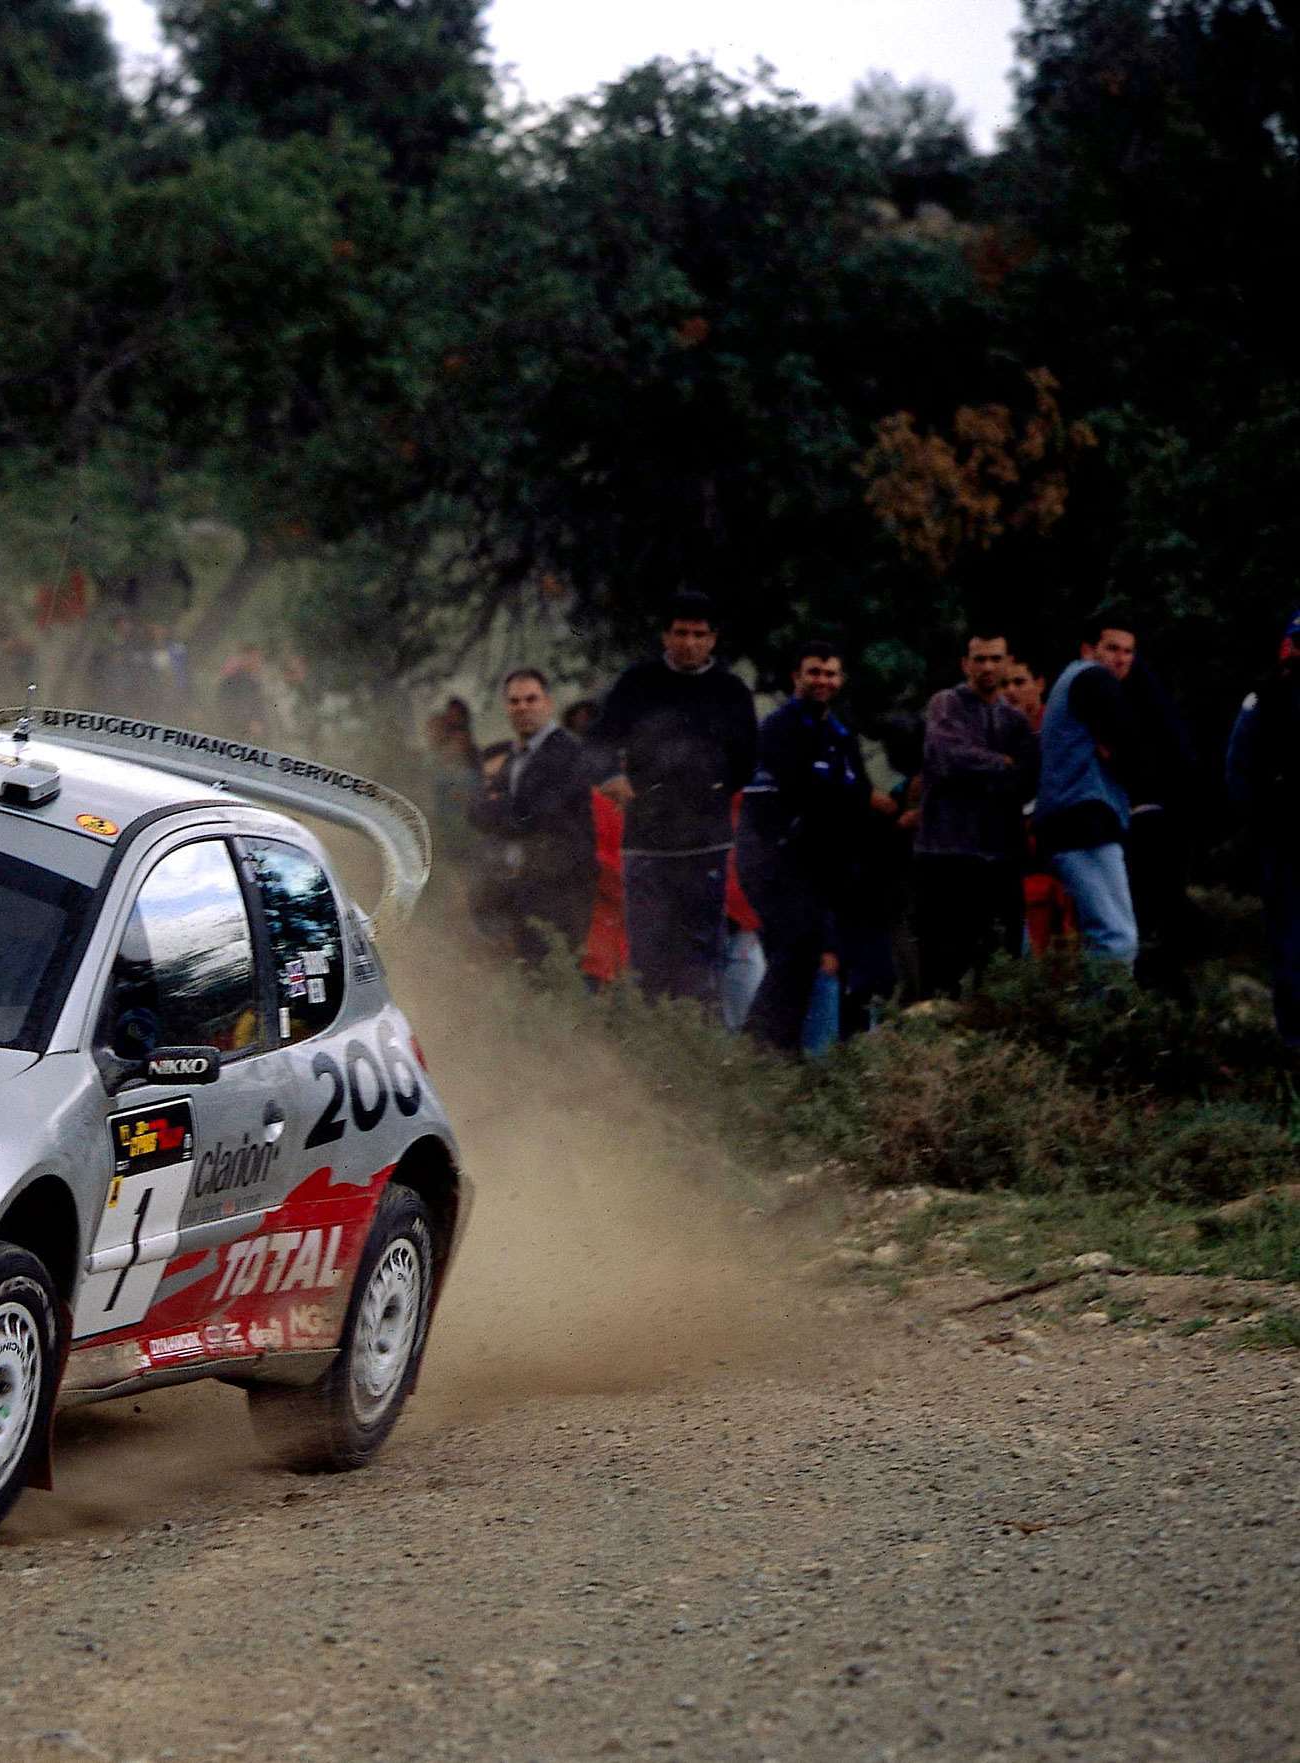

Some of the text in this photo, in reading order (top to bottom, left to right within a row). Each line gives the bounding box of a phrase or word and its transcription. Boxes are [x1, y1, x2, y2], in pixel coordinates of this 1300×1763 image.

[64, 712, 161, 741] PEUGEOT
[163, 730, 273, 768] FINANCIAL
[148, 1058, 208, 1075] NIKKO
[305, 1019, 421, 1150] 206
[103, 1188, 153, 1312] 1
[213, 1225, 342, 1301] TOTAL
